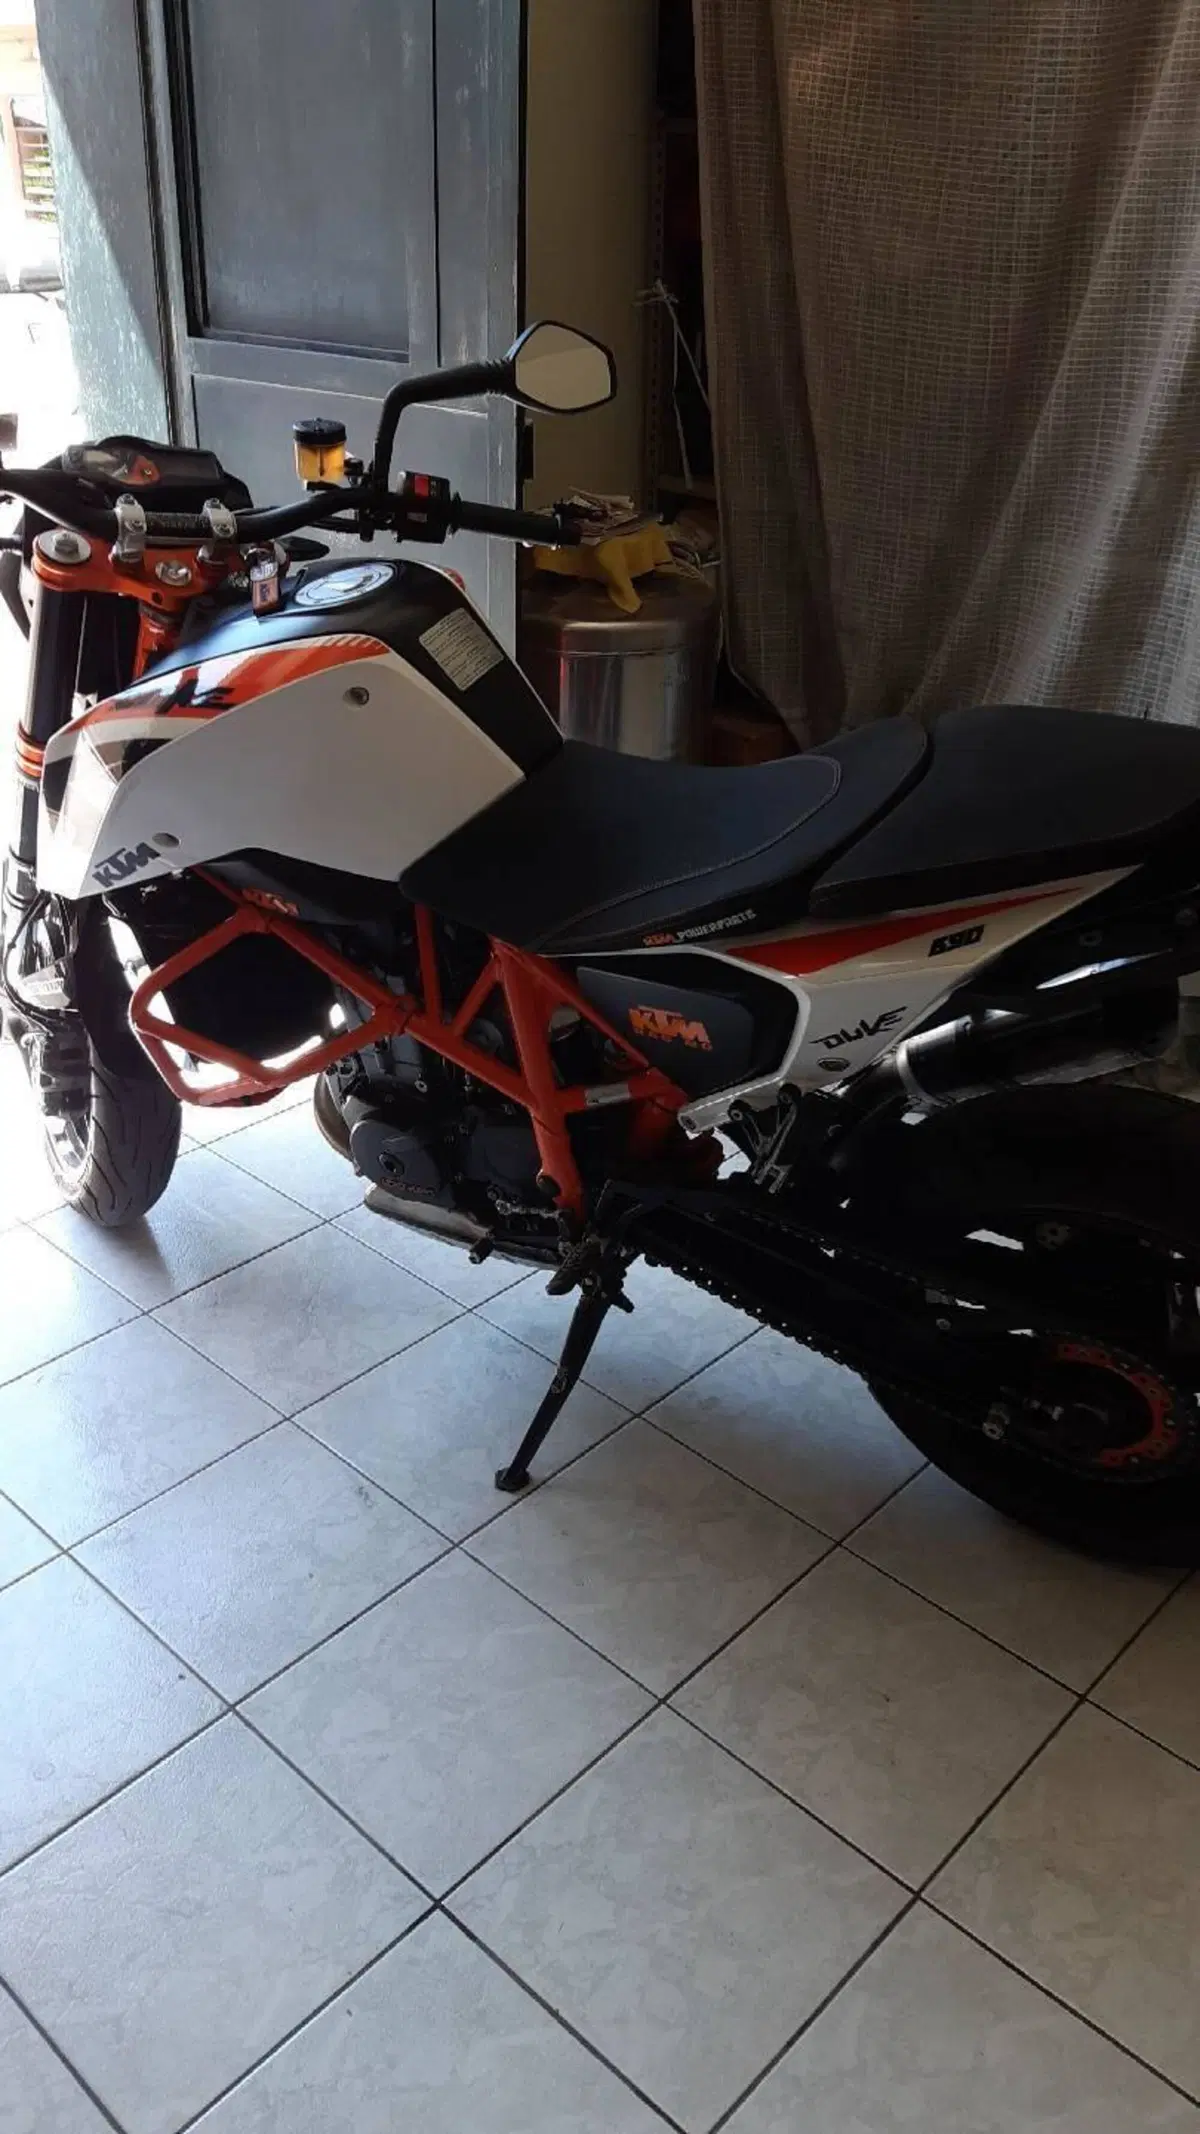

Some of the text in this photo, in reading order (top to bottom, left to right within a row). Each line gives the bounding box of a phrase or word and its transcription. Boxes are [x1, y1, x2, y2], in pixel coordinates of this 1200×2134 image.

[92, 842, 161, 888] KTM
[928, 924, 985, 957] 690
[628, 1004, 709, 1044] KTM
[809, 1005, 908, 1049] DUKE
